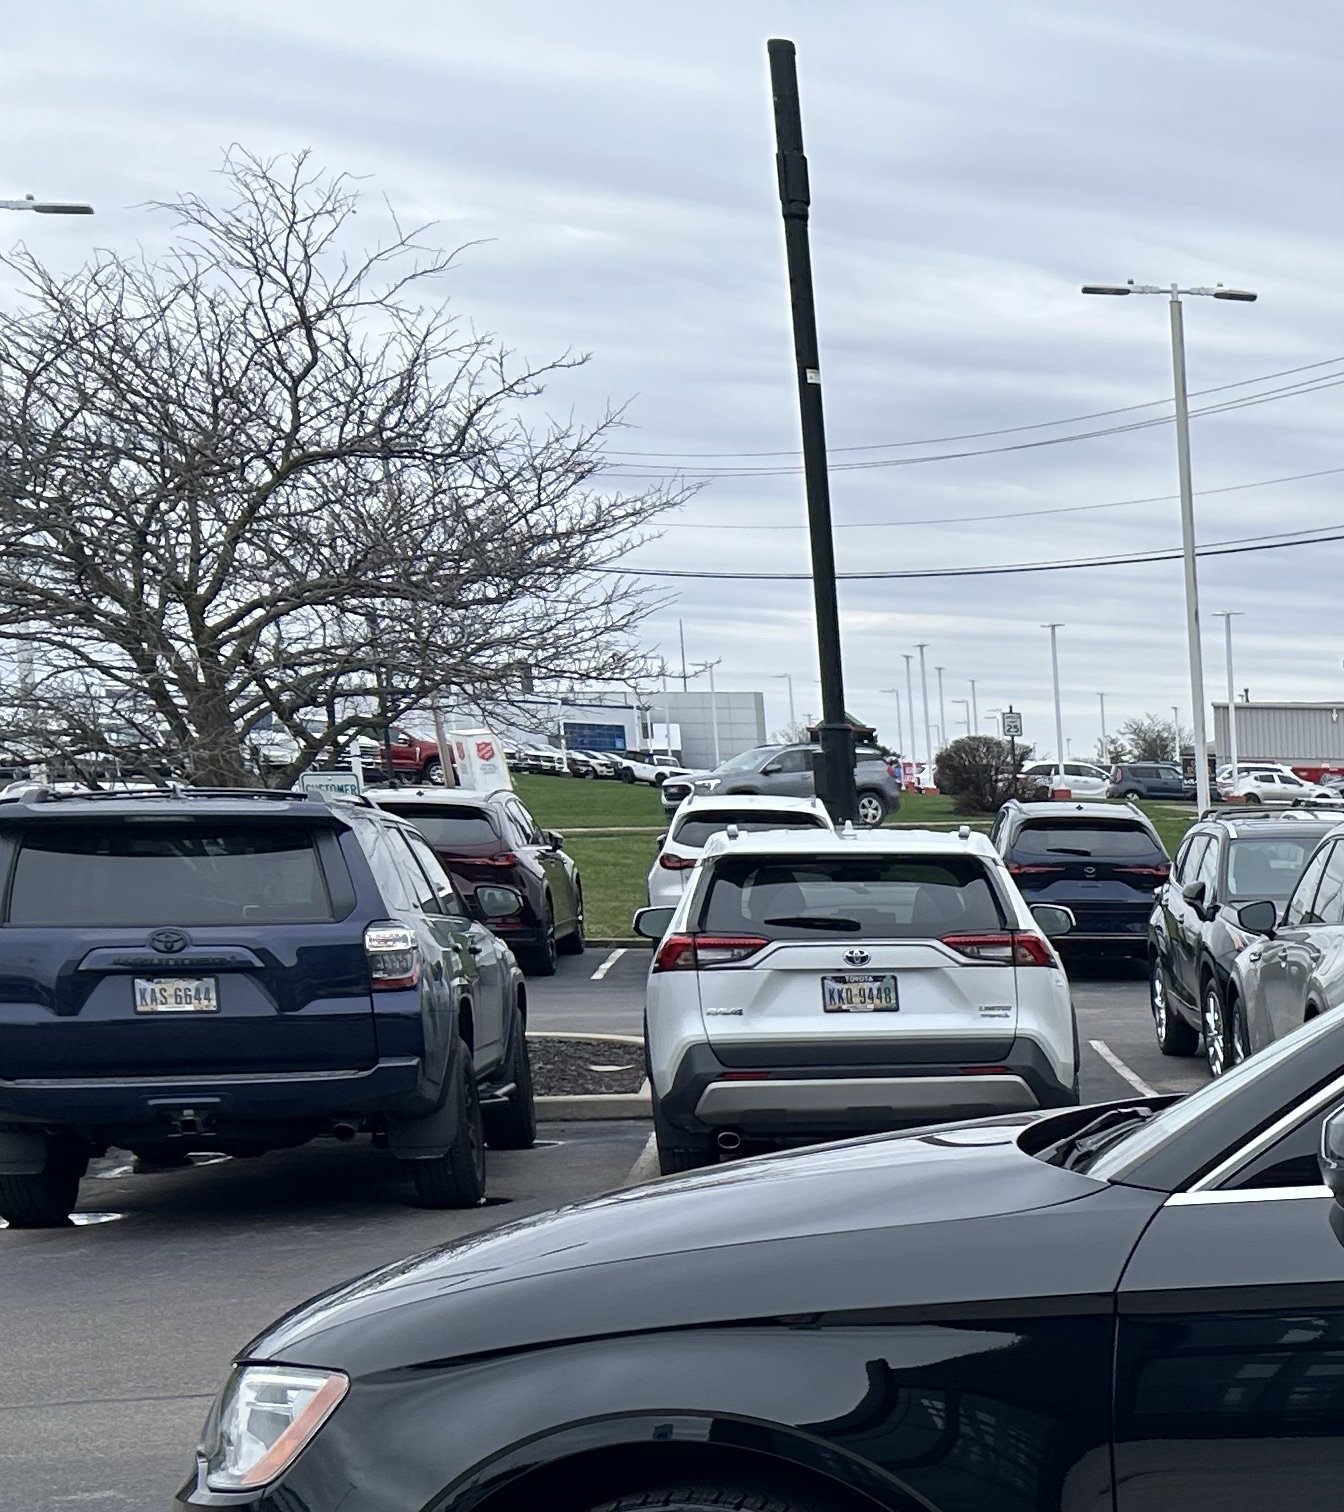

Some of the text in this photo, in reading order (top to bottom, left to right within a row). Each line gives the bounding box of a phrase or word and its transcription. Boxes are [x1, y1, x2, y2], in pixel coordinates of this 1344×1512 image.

[1006, 724, 1020, 733] 25
[139, 987, 212, 1006] KAS 6644
